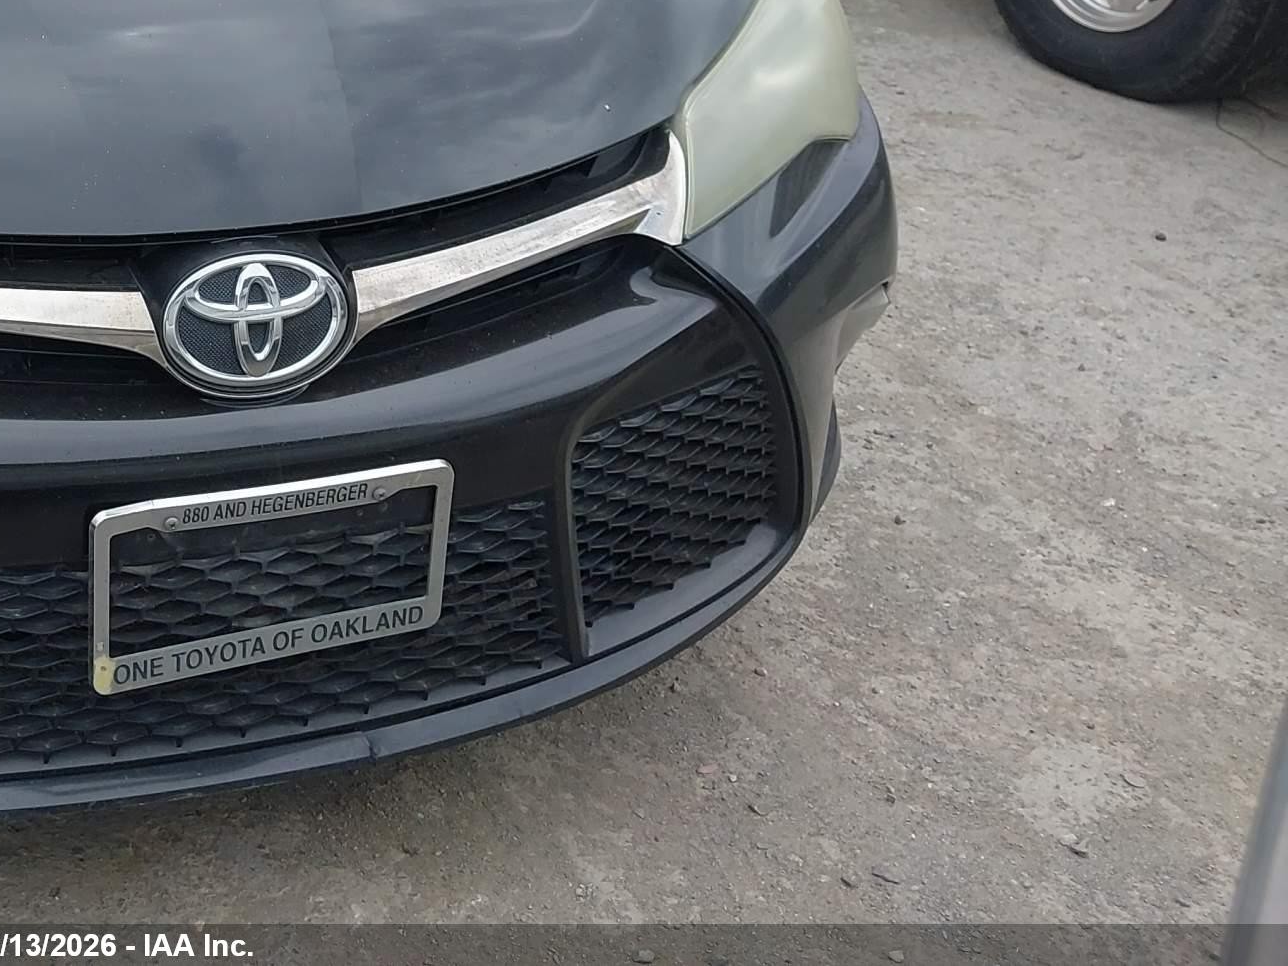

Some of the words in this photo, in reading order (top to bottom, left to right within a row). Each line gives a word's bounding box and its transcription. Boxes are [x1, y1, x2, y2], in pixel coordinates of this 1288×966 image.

[182, 504, 210, 525] 880
[214, 499, 246, 520] AND
[251, 483, 368, 516] HEGENBERGER
[114, 655, 165, 685] ONE
[171, 636, 266, 673] TOYOTA
[272, 626, 303, 652] OF
[311, 605, 424, 643] OAKLAND
